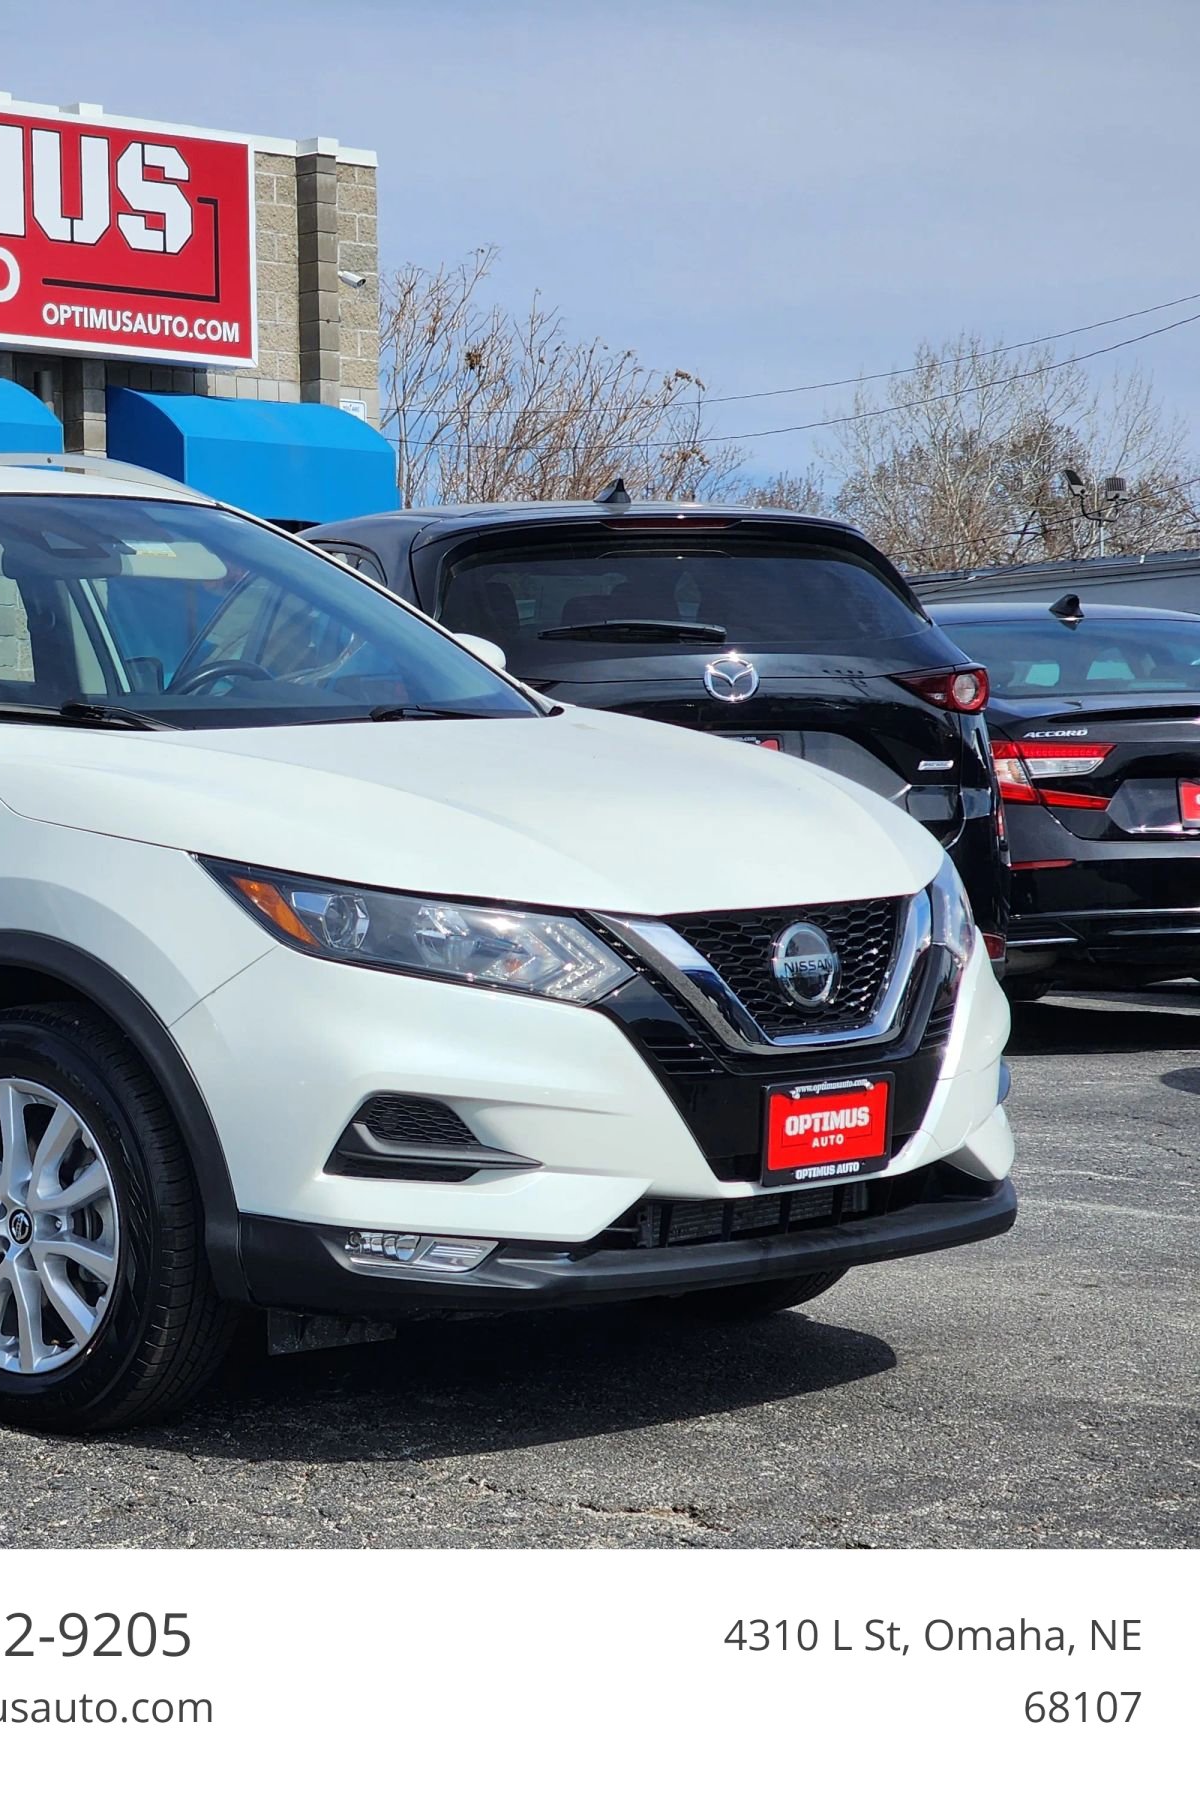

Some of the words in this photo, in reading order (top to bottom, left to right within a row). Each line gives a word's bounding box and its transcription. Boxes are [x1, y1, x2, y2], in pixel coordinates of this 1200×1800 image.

[41, 301, 241, 344] OPTIMUSAUTO.COM
[1023, 728, 1089, 739] ACCORD
[783, 958, 833, 974] NISSAN
[794, 1079, 870, 1095] www.optimusauto.com
[785, 1106, 870, 1137] OPTIMUS
[812, 1133, 845, 1148] AUTO
[795, 1164, 836, 1180] OPTIMUS
[836, 1161, 860, 1174] AUTO
